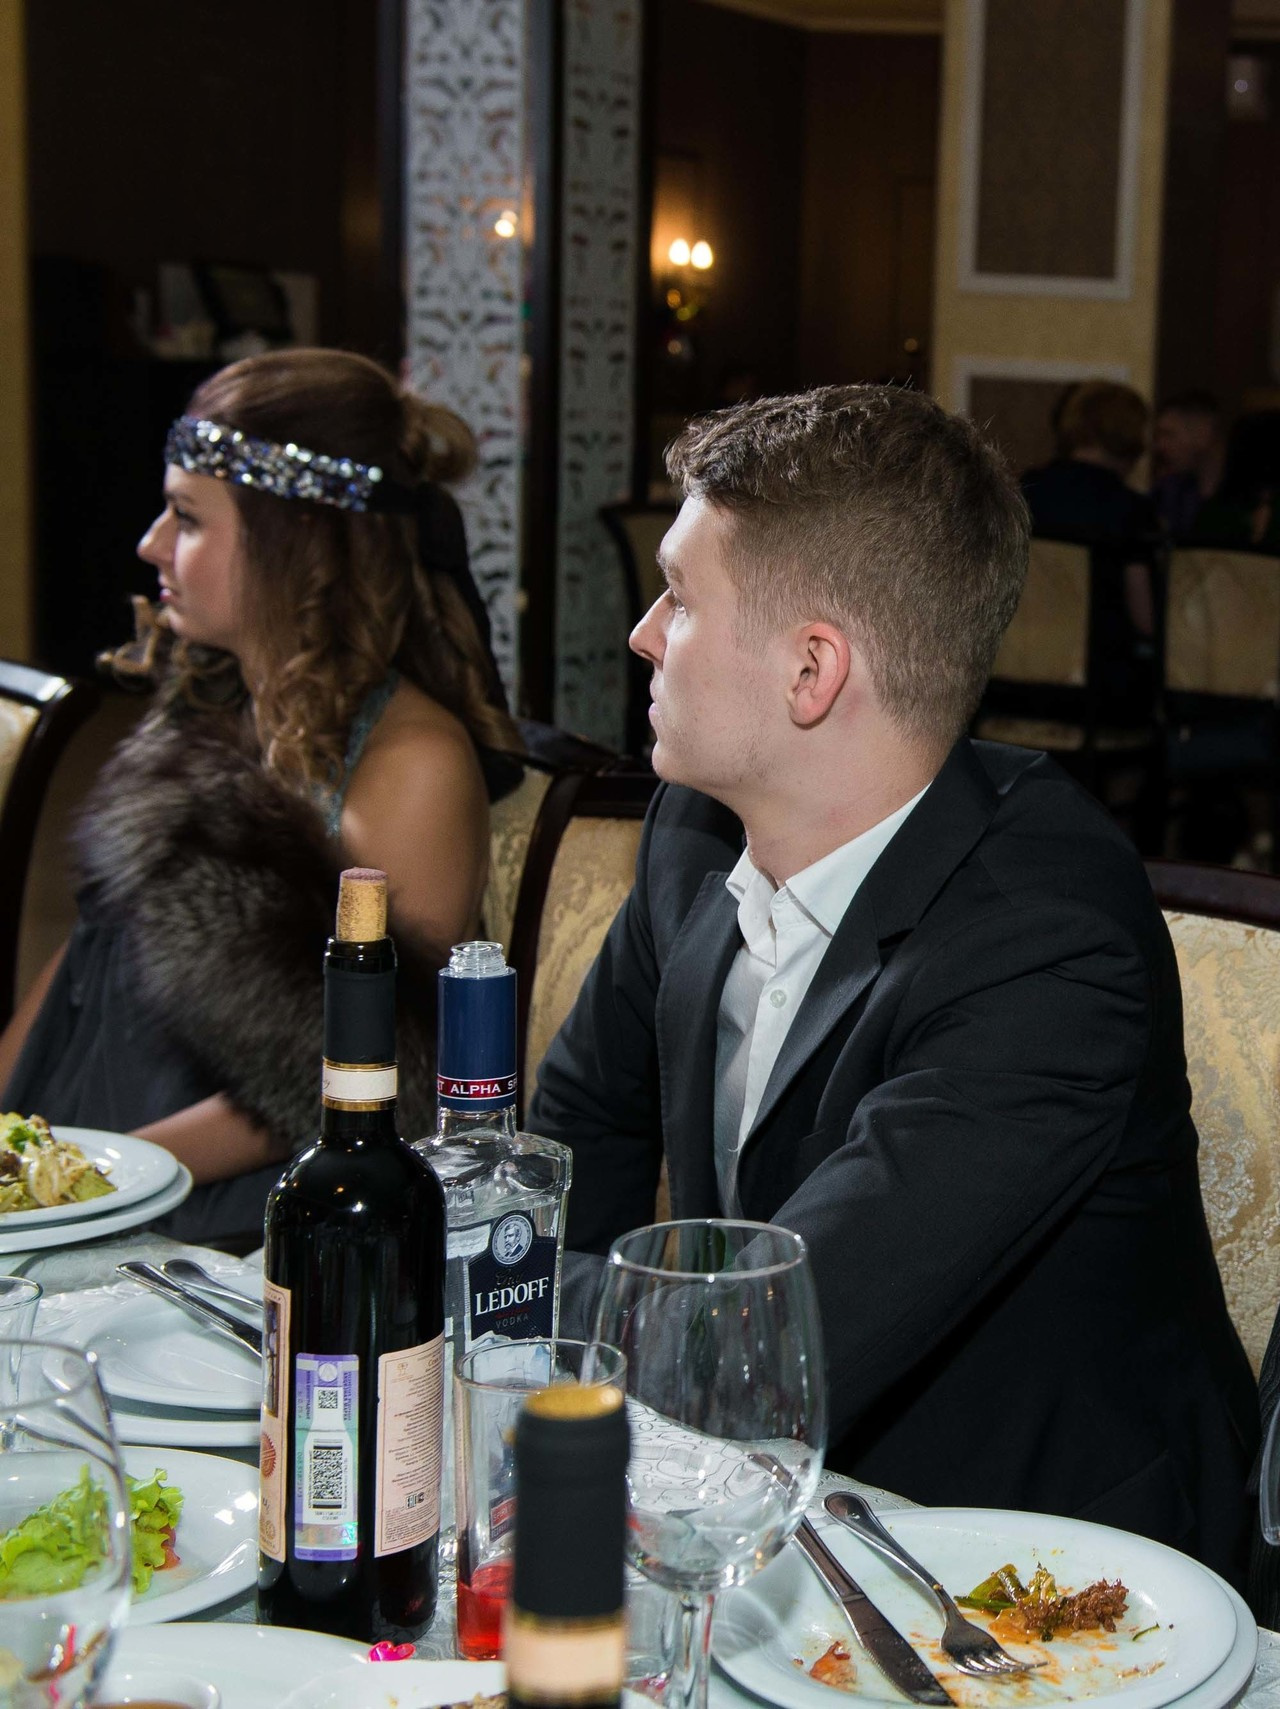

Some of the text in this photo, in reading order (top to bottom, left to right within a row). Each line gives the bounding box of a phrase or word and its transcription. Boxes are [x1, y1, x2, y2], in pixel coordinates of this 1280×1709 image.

[450, 1083, 502, 1095] ALPHA
[475, 1277, 550, 1316] LEDOFF
[495, 1313, 529, 1329] VODKA
